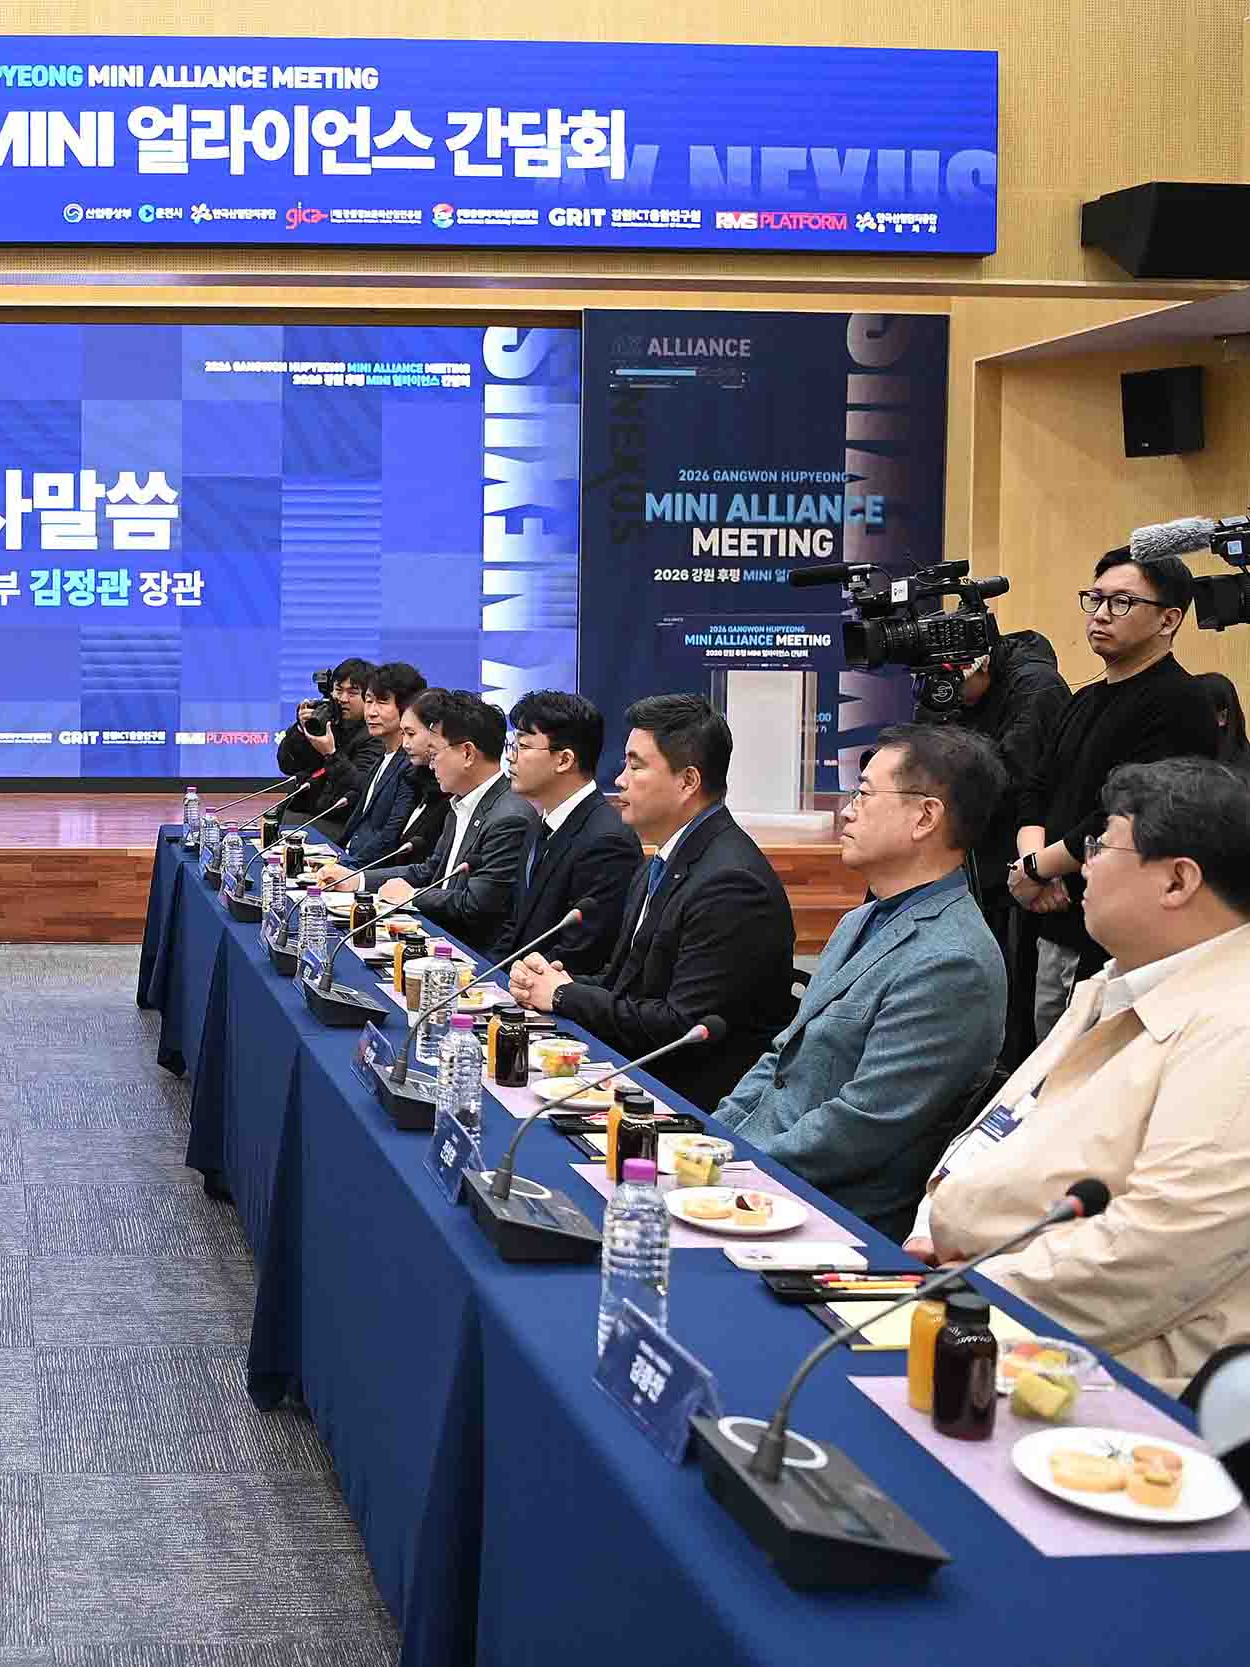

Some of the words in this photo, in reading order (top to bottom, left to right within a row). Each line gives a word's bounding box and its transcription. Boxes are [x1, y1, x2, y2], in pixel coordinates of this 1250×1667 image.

[88, 66, 144, 88] MINI
[149, 66, 267, 89] ALLIANCE
[272, 66, 379, 90] MEETING
[127, 104, 436, 177] 얼라이언스
[445, 106, 626, 180] 간담회
[548, 208, 607, 226] GRIT
[758, 212, 847, 231] PLATFORM
[647, 336, 752, 357] ALLIANCE
[678, 469, 710, 482] 2026
[713, 470, 778, 483] GANGWON
[781, 470, 849, 483] HUPYEONG
[645, 492, 718, 523] MINI
[725, 493, 886, 524] ALLIANCE
[692, 527, 834, 558] MEETING
[653, 568, 689, 582] 2026
[691, 567, 715, 583] 강원
[717, 567, 741, 582] 후평
[743, 568, 772, 581] MINI
[29, 568, 132, 607] 김정관
[138, 569, 205, 607] 장관
[685, 634, 712, 646] MINI
[714, 634, 773, 646] ALLIANCE
[776, 634, 832, 647] MEETING
[58, 731, 100, 745] GRIT
[206, 732, 270, 745] PLATFORM
